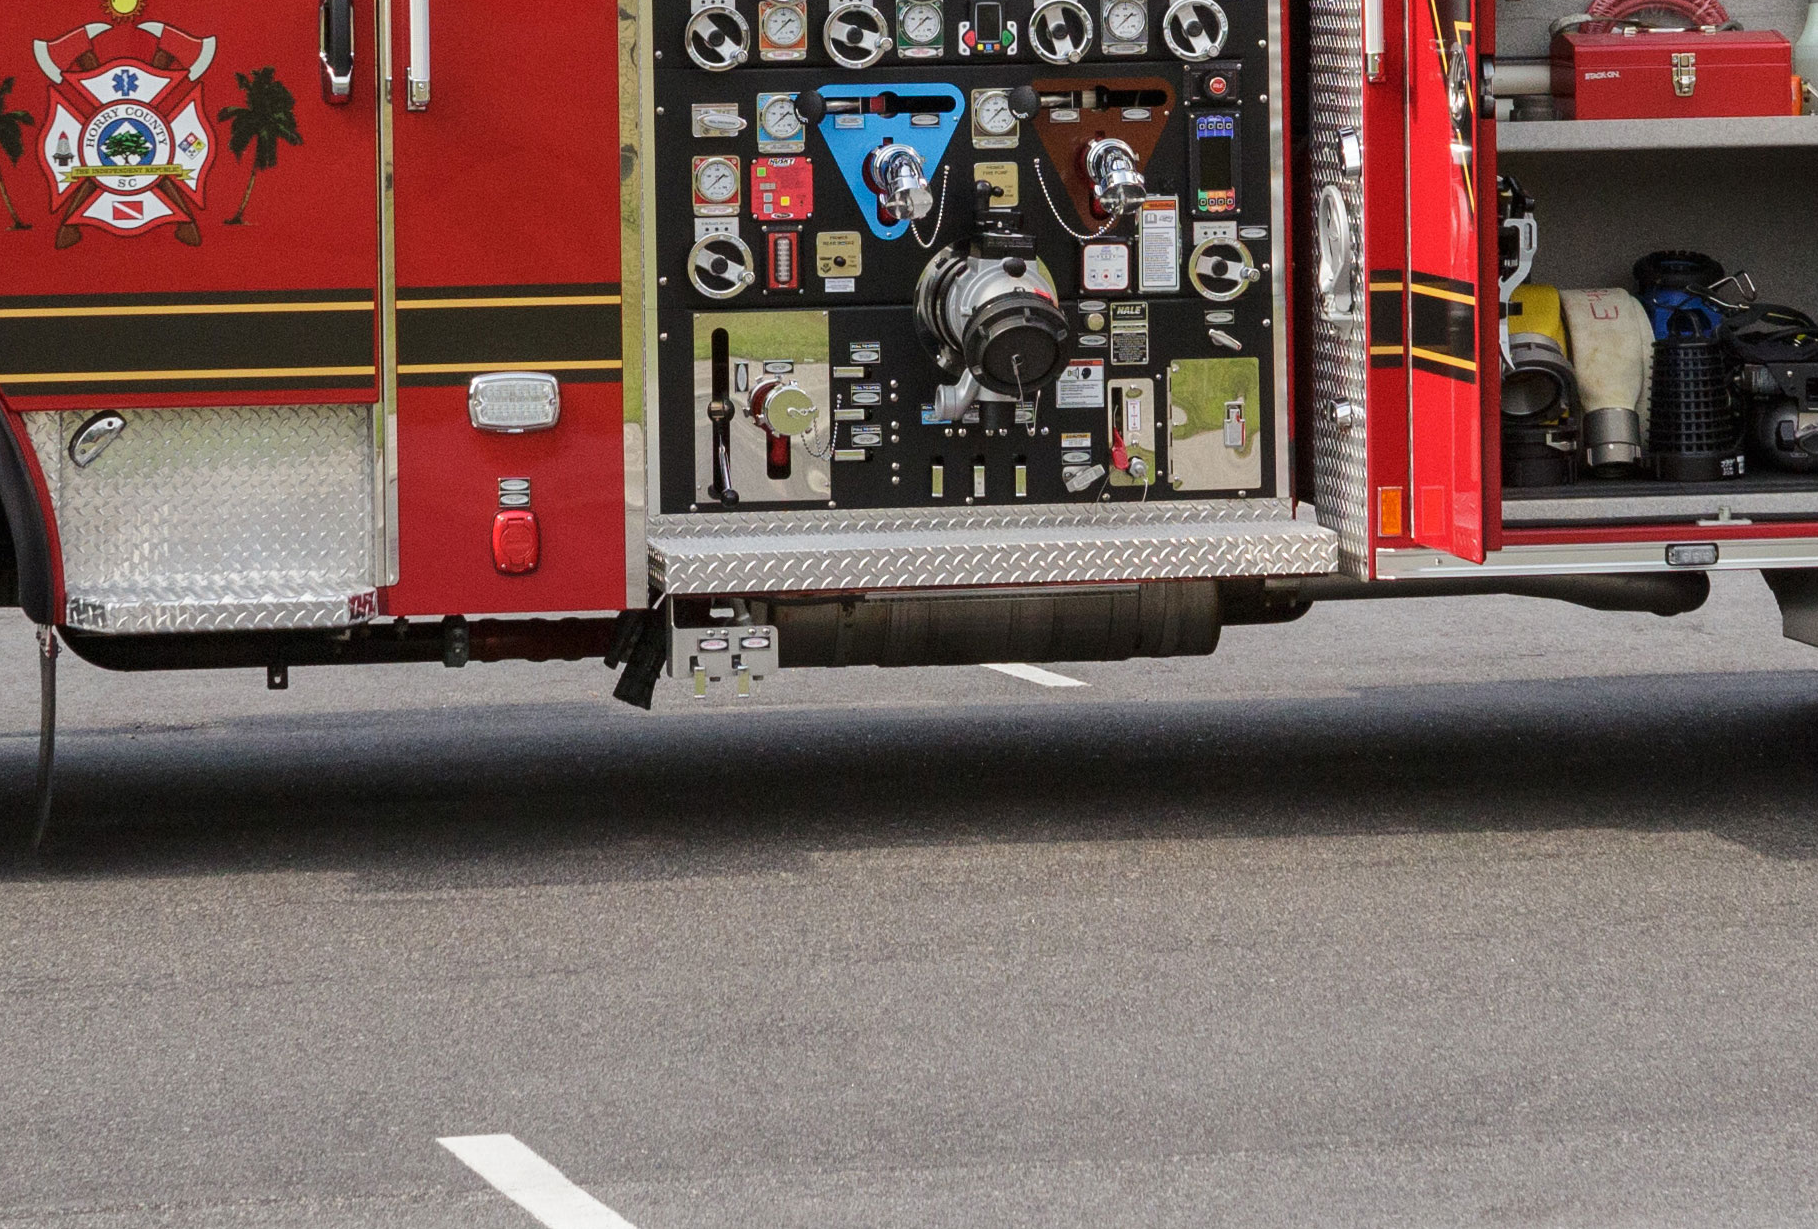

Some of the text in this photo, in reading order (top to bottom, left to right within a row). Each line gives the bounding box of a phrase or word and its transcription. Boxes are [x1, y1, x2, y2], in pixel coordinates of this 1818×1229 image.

[86, 106, 168, 148] HORRY COUNTY
[92, 166, 142, 174] INDEPENDENT
[1116, 305, 1141, 315] HALE
